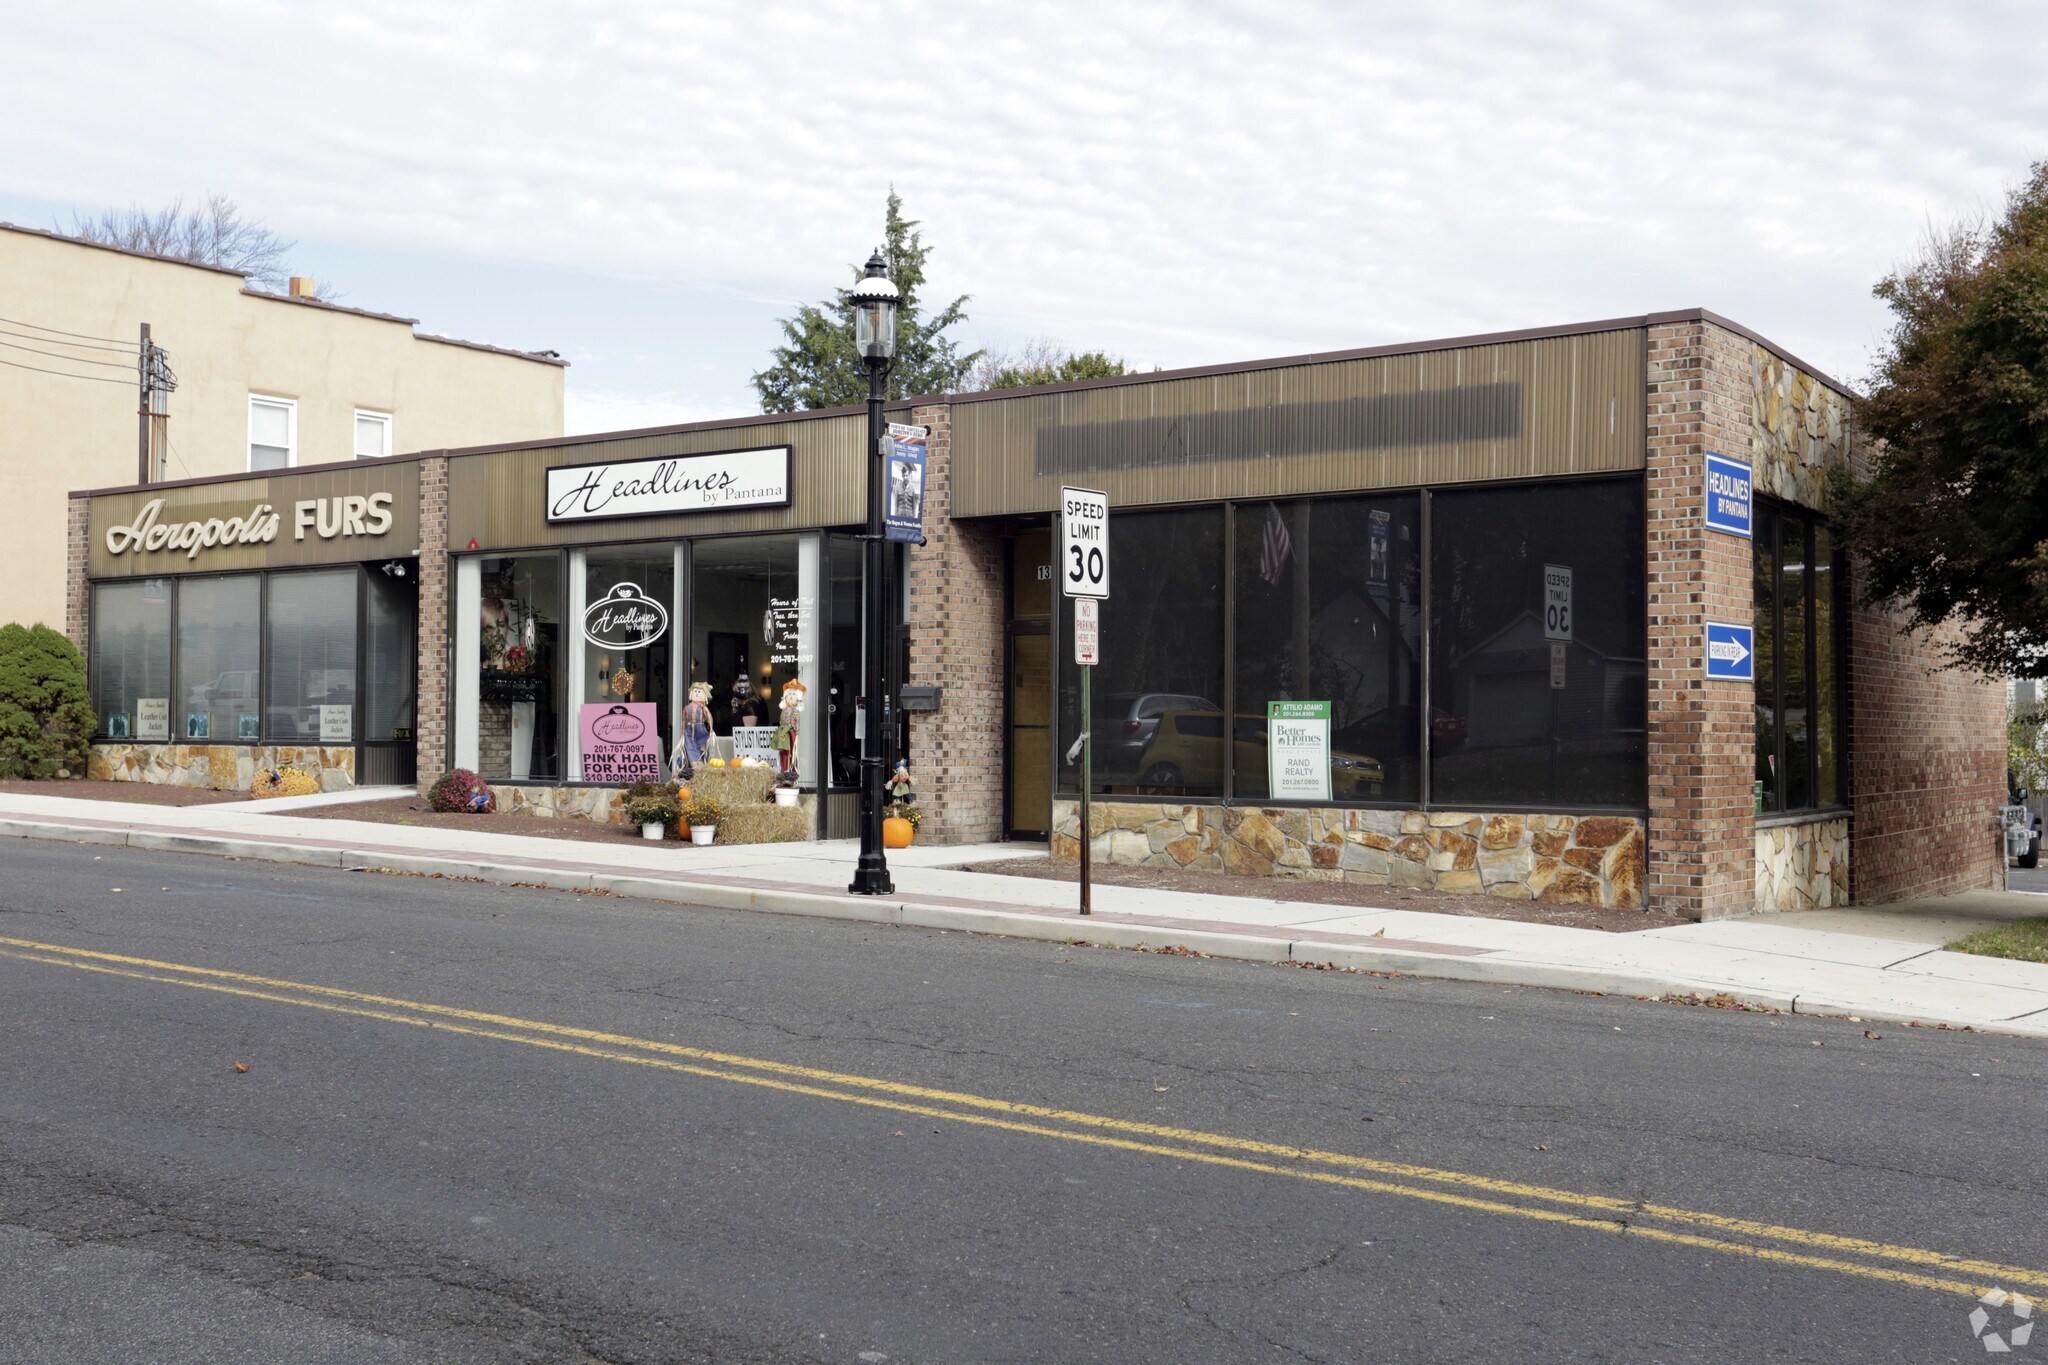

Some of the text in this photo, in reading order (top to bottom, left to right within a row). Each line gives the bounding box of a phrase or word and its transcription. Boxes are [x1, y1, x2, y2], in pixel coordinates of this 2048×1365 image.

[552, 461, 738, 516] Headlines
[1709, 470, 1749, 501] HEADLINES
[703, 486, 783, 506] by Pantana
[1067, 500, 1104, 519] SPEED
[1718, 497, 1748, 519] BY PANTANA
[106, 492, 393, 559] Acropolis FURS
[1071, 523, 1100, 540] LIMIT
[1069, 544, 1104, 584] 30
[771, 598, 790, 607] Hours
[792, 599, 799, 608] of
[1082, 605, 1091, 617] NO
[592, 607, 658, 633] Headlines
[626, 623, 632, 632] by
[1077, 620, 1096, 632] PARKING
[783, 631, 800, 641] Friday
[1078, 634, 1096, 643] HERE TO
[1079, 644, 1096, 653] CORNER
[1711, 644, 1727, 657] PARKING
[1731, 646, 1741, 658] REAR
[771, 654, 814, 663] 201-767-0097
[597, 720, 639, 735] Headlines
[1277, 725, 1306, 736] Better
[735, 731, 754, 749] STYLIST
[1287, 735, 1321, 746] Homes
[594, 744, 644, 753] 201-767-0097
[583, 754, 657, 763] PINK HAIR
[1287, 759, 1311, 767] RAND
[584, 764, 658, 774] FOR HOPE
[1285, 768, 1314, 776] REALTY
[585, 774, 602, 782] $10
